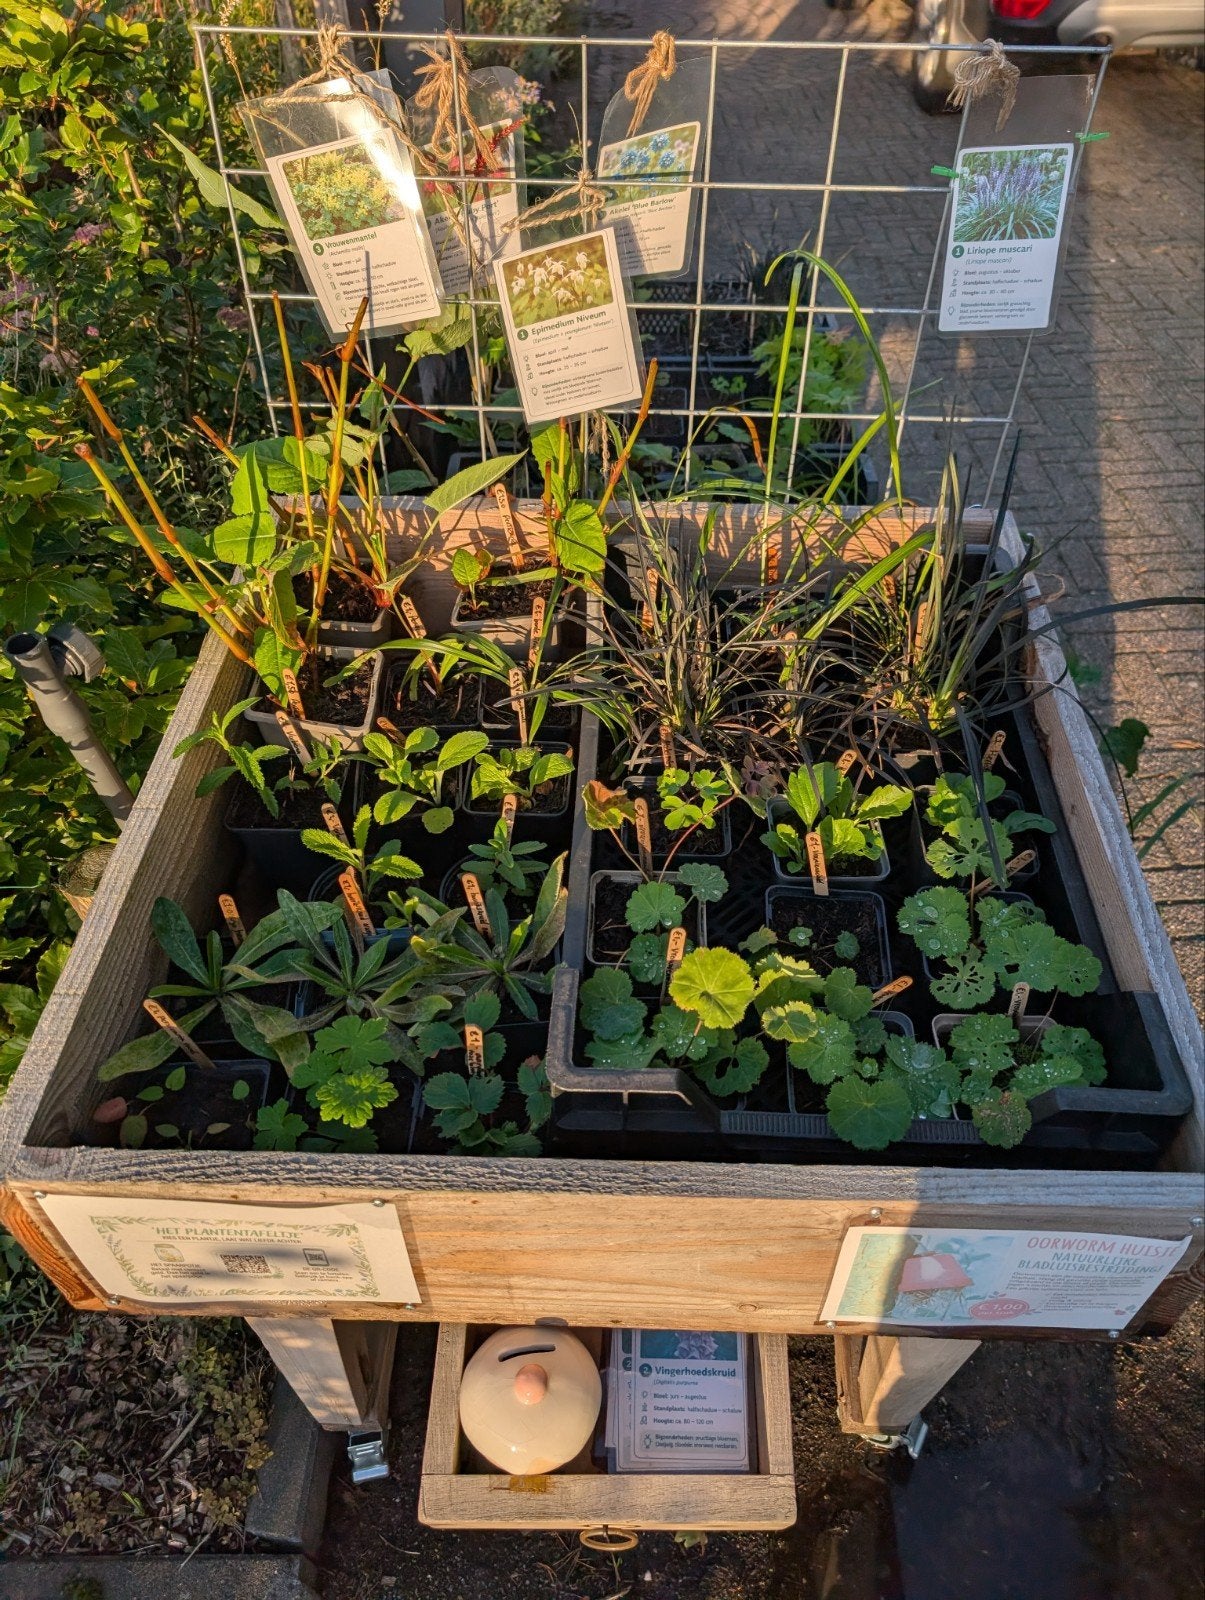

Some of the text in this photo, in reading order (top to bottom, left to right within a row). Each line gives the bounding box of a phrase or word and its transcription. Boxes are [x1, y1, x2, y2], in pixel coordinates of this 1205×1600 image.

[651, 196, 676, 207] Barlow'
[325, 232, 377, 248] Vrouwenmantel
[967, 246, 997, 256] Liriope
[999, 245, 1033, 253] muscari
[532, 319, 574, 336] Epimedium
[577, 311, 606, 323] Niveum
[1027, 1237, 1181, 1258] OORWORM HUISJE
[1052, 1252, 1140, 1266] NATUURLIJKE
[1018, 1260, 1163, 1273] BLADLUISBESTRIJDING!
[655, 1366, 736, 1379] Vingerhoedskruid
